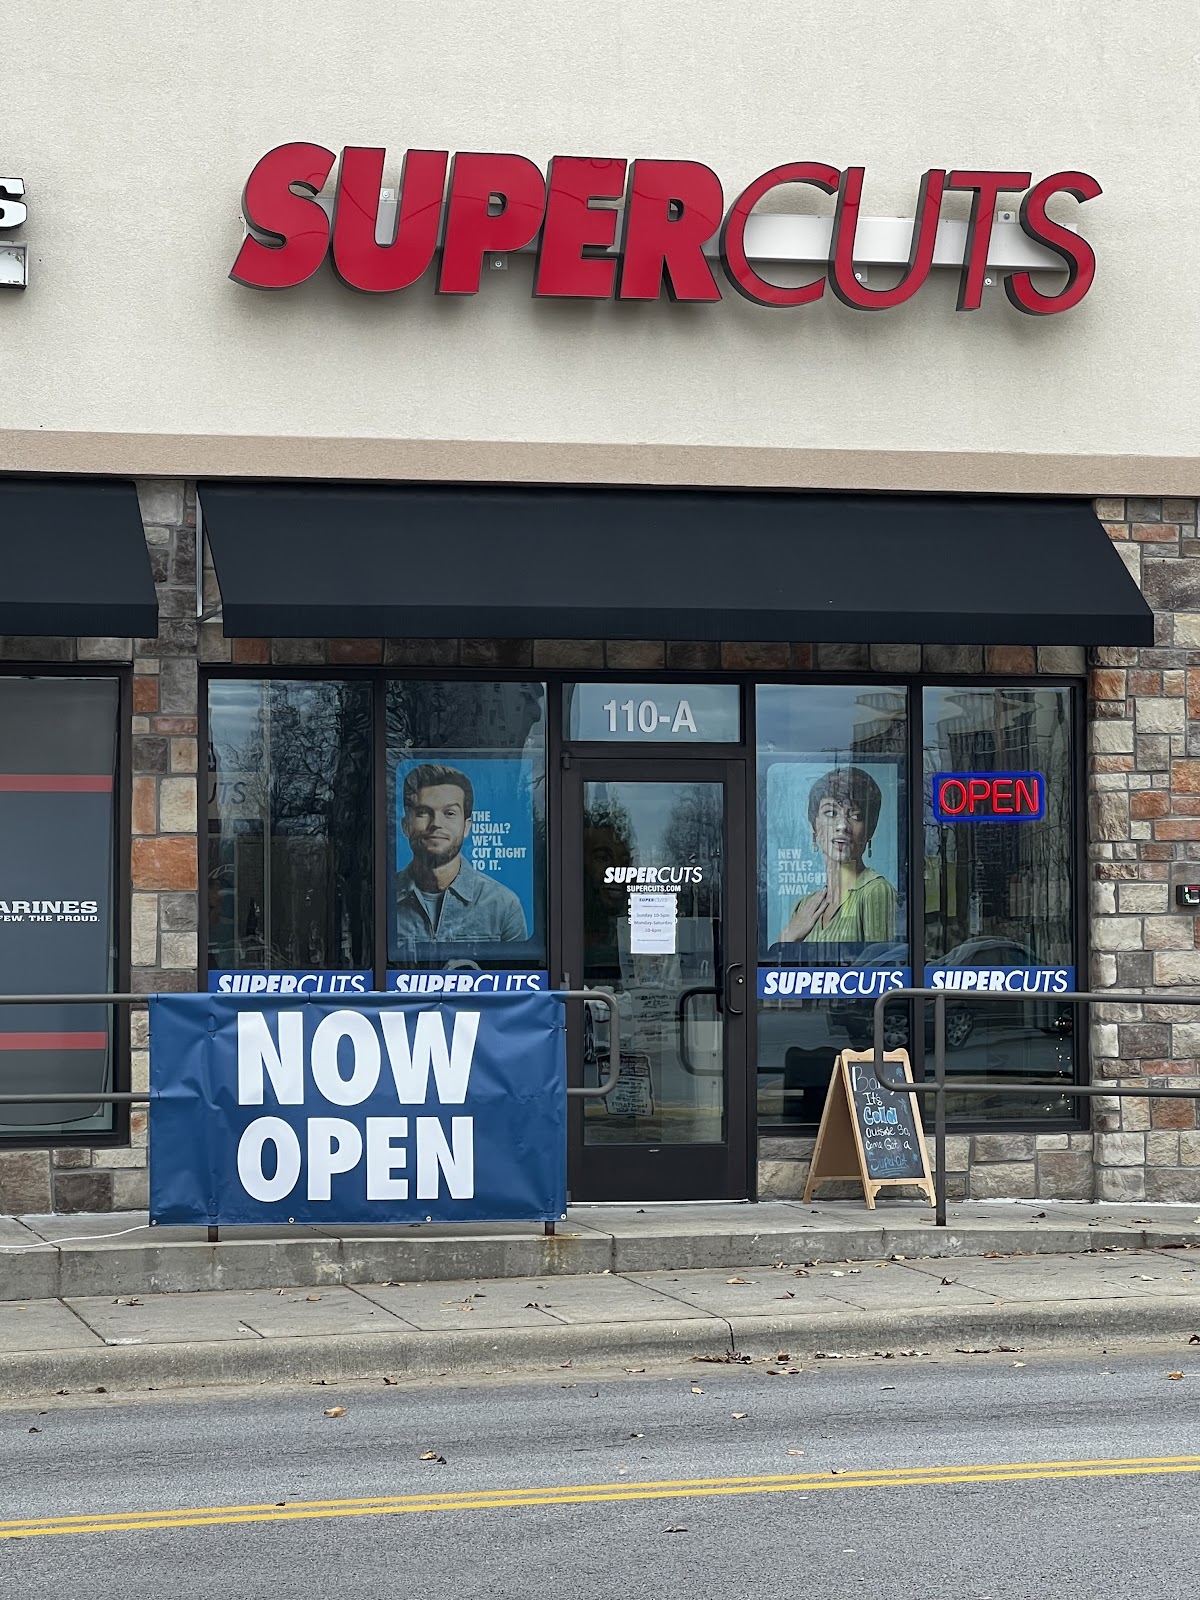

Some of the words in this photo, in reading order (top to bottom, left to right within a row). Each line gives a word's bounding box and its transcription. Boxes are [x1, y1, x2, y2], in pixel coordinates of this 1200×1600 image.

[228, 141, 1103, 315] SUPERCUTS
[603, 699, 698, 733] 110-A
[940, 779, 1039, 814] OPEN
[472, 810, 491, 822] THE
[472, 822, 511, 834] USUAL?
[472, 847, 491, 859] CUT
[494, 847, 527, 859] RIGHT
[777, 848, 802, 860] NEW
[472, 859, 486, 871] TO
[489, 859, 502, 871] IT.
[778, 860, 813, 872] STYLE?
[603, 866, 703, 884] SUPERCUTS
[778, 872, 827, 884] STRAIGHT
[626, 884, 682, 893] SUPERCUTS.COM
[778, 884, 811, 896] AWAY.
[28, 914, 53, 922] THE
[56, 914, 101, 922] PROUD.
[216, 974, 366, 993] SUPERCUTS
[394, 973, 541, 992] SUPERCUTS
[763, 969, 905, 995] SUPERCUTS
[931, 968, 1069, 993] SUPERCUTS
[237, 1009, 481, 1106] NOW
[862, 1091, 883, 1106] It's
[237, 1115, 475, 1202] OPEN
